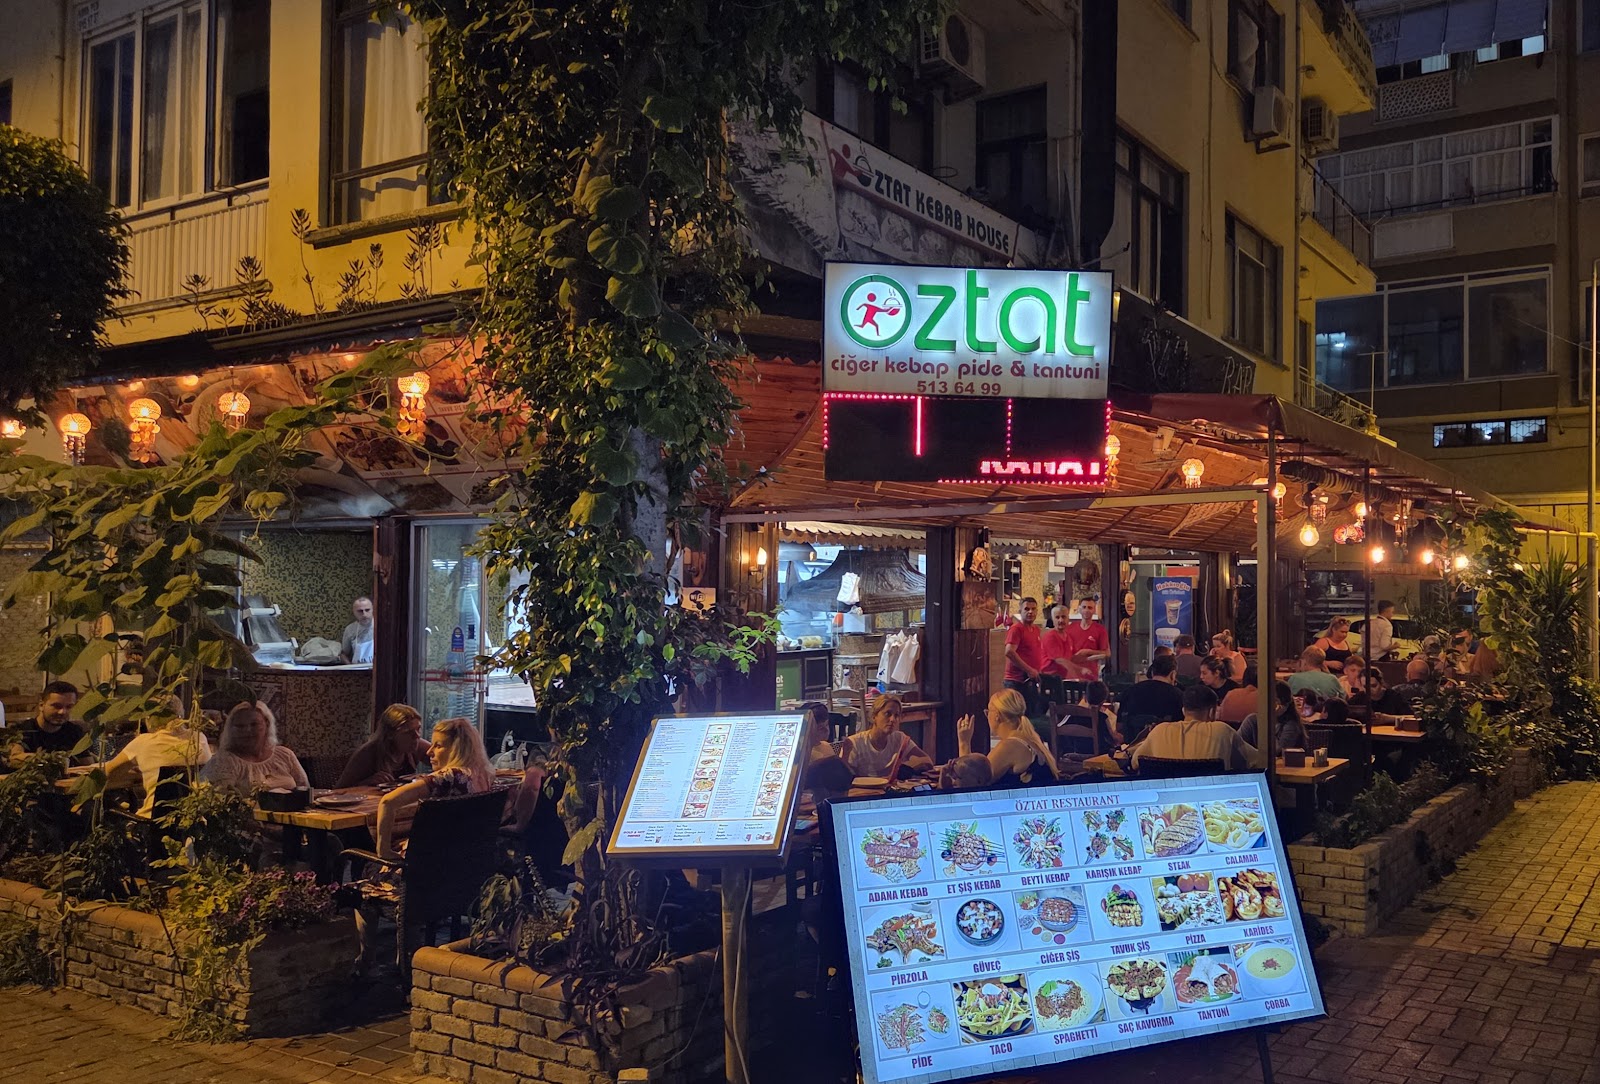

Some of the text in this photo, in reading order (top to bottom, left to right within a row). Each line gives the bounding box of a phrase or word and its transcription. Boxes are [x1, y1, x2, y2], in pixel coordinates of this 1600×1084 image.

[916, 190, 963, 231] KEBAB
[967, 215, 1009, 254] HOUSE
[831, 354, 1101, 380] ciğer kebap pide & tantuni
[917, 380, 1002, 396] 513 64 99
[1015, 794, 1120, 812] ÖZTAT RESTAURANT
[1168, 860, 1191, 871] STEAK
[1225, 853, 1259, 865] CALAMAR
[1021, 872, 1071, 886] BEYTİ KEBAP
[1086, 865, 1143, 880] KARIŞIK KEBAP
[947, 879, 1001, 895] ET ŞİŞ KEBAB
[868, 887, 929, 903] ADANA KEBAB
[1185, 933, 1207, 945] PİZZA
[1242, 925, 1275, 938] KARİDES
[1110, 940, 1151, 955] TAVUK ŞİŞ
[1040, 949, 1081, 965] CİĞER ŞİŞ
[973, 959, 1001, 974] GÜVEÇ
[891, 970, 928, 986] PİRZOLA
[1264, 998, 1291, 1011] ÇORBA
[1197, 1006, 1230, 1021] TANTUNİ
[1118, 1015, 1175, 1035] SAÇ KAVURMA
[989, 1042, 1013, 1055] TACO
[911, 1056, 933, 1070] PİDE
